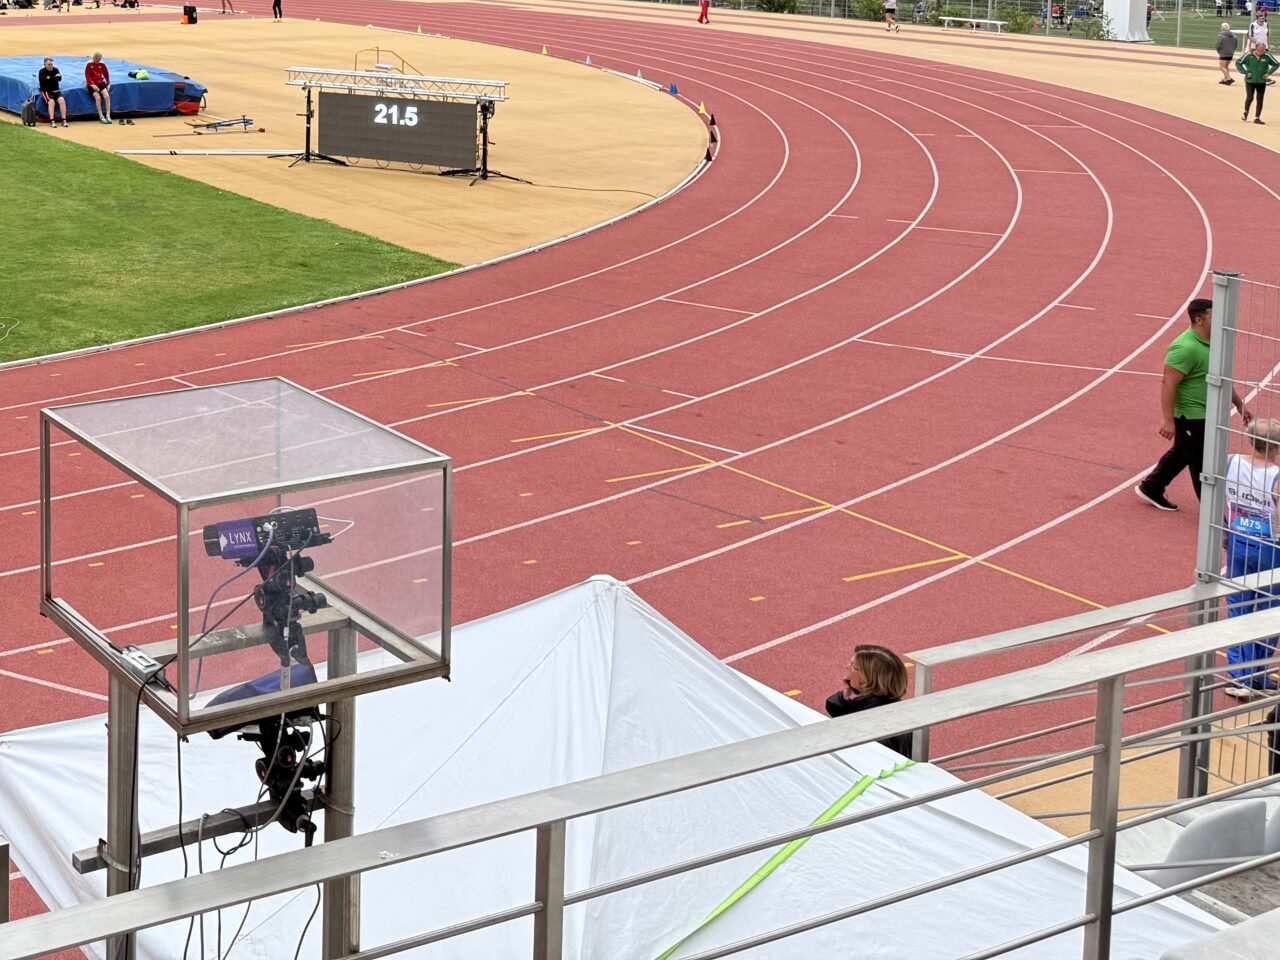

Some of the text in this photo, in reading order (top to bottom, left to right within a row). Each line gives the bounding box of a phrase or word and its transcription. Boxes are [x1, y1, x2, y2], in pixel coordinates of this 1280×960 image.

[374, 103, 418, 127] 21.5
[1239, 517, 1261, 530] M75
[229, 531, 252, 544] LYNX
